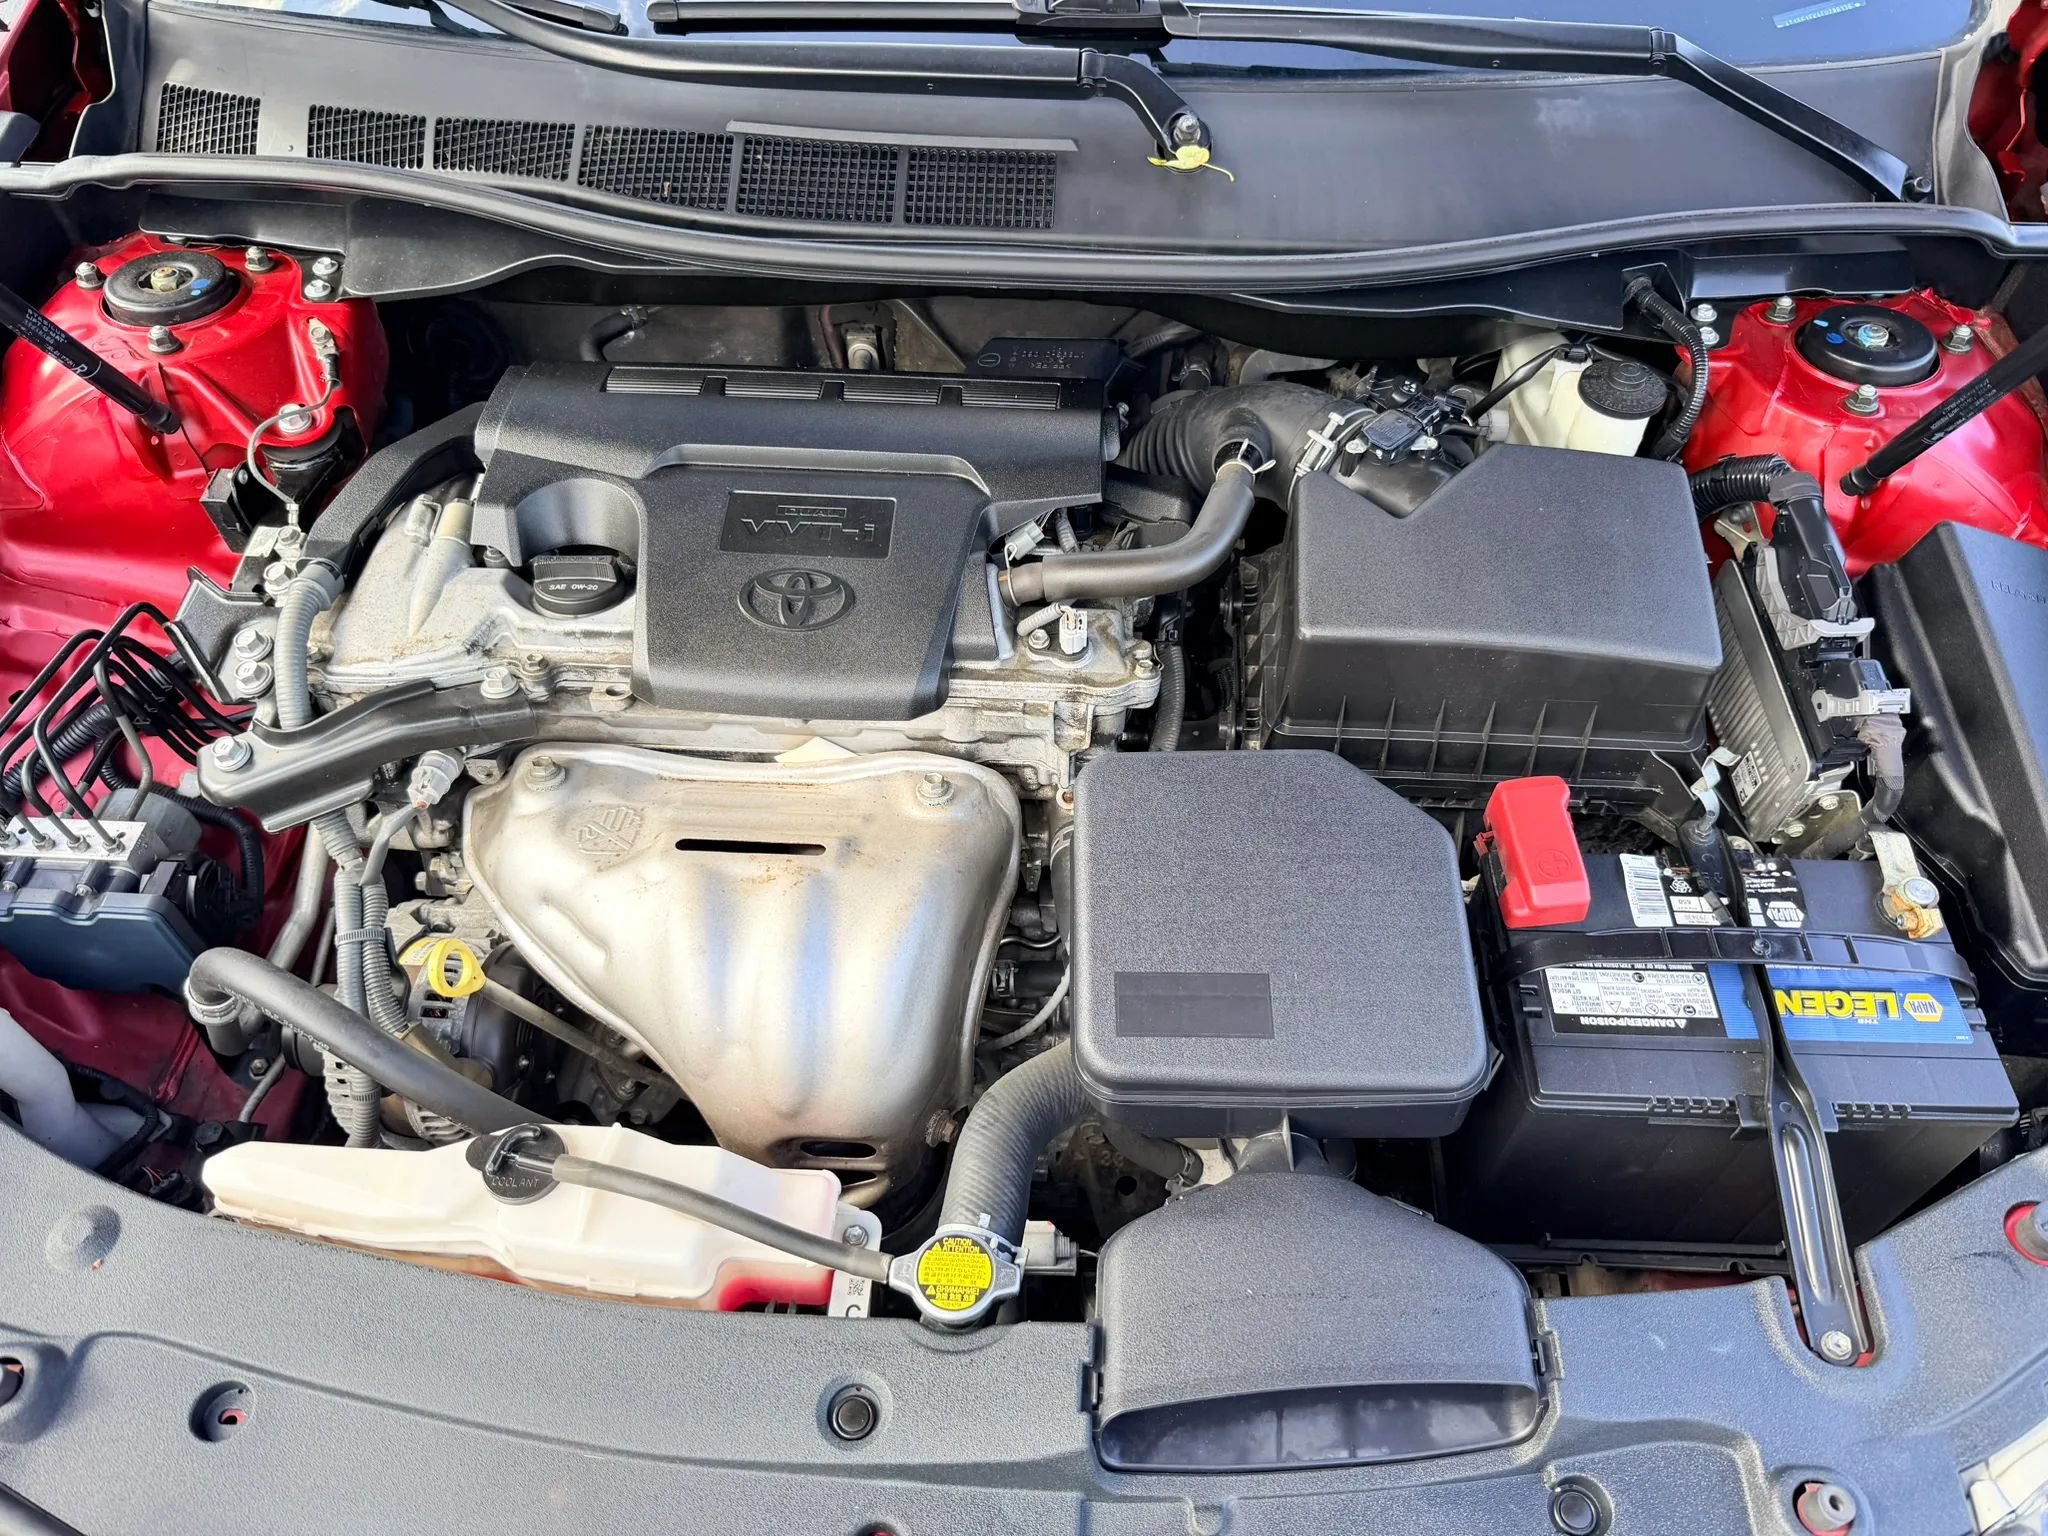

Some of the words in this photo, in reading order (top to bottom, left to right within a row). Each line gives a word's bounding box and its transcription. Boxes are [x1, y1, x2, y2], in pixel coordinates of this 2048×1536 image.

[548, 583, 567, 591] SAE
[1769, 908, 1800, 922] NAPA
[1908, 1000, 1938, 1014] NAPA
[1580, 1016, 1677, 1028] DANGER/POISON
[491, 1175, 540, 1188] COOLANT
[943, 1237, 972, 1246] CAUTION
[943, 1244, 980, 1254] ATTENTION
